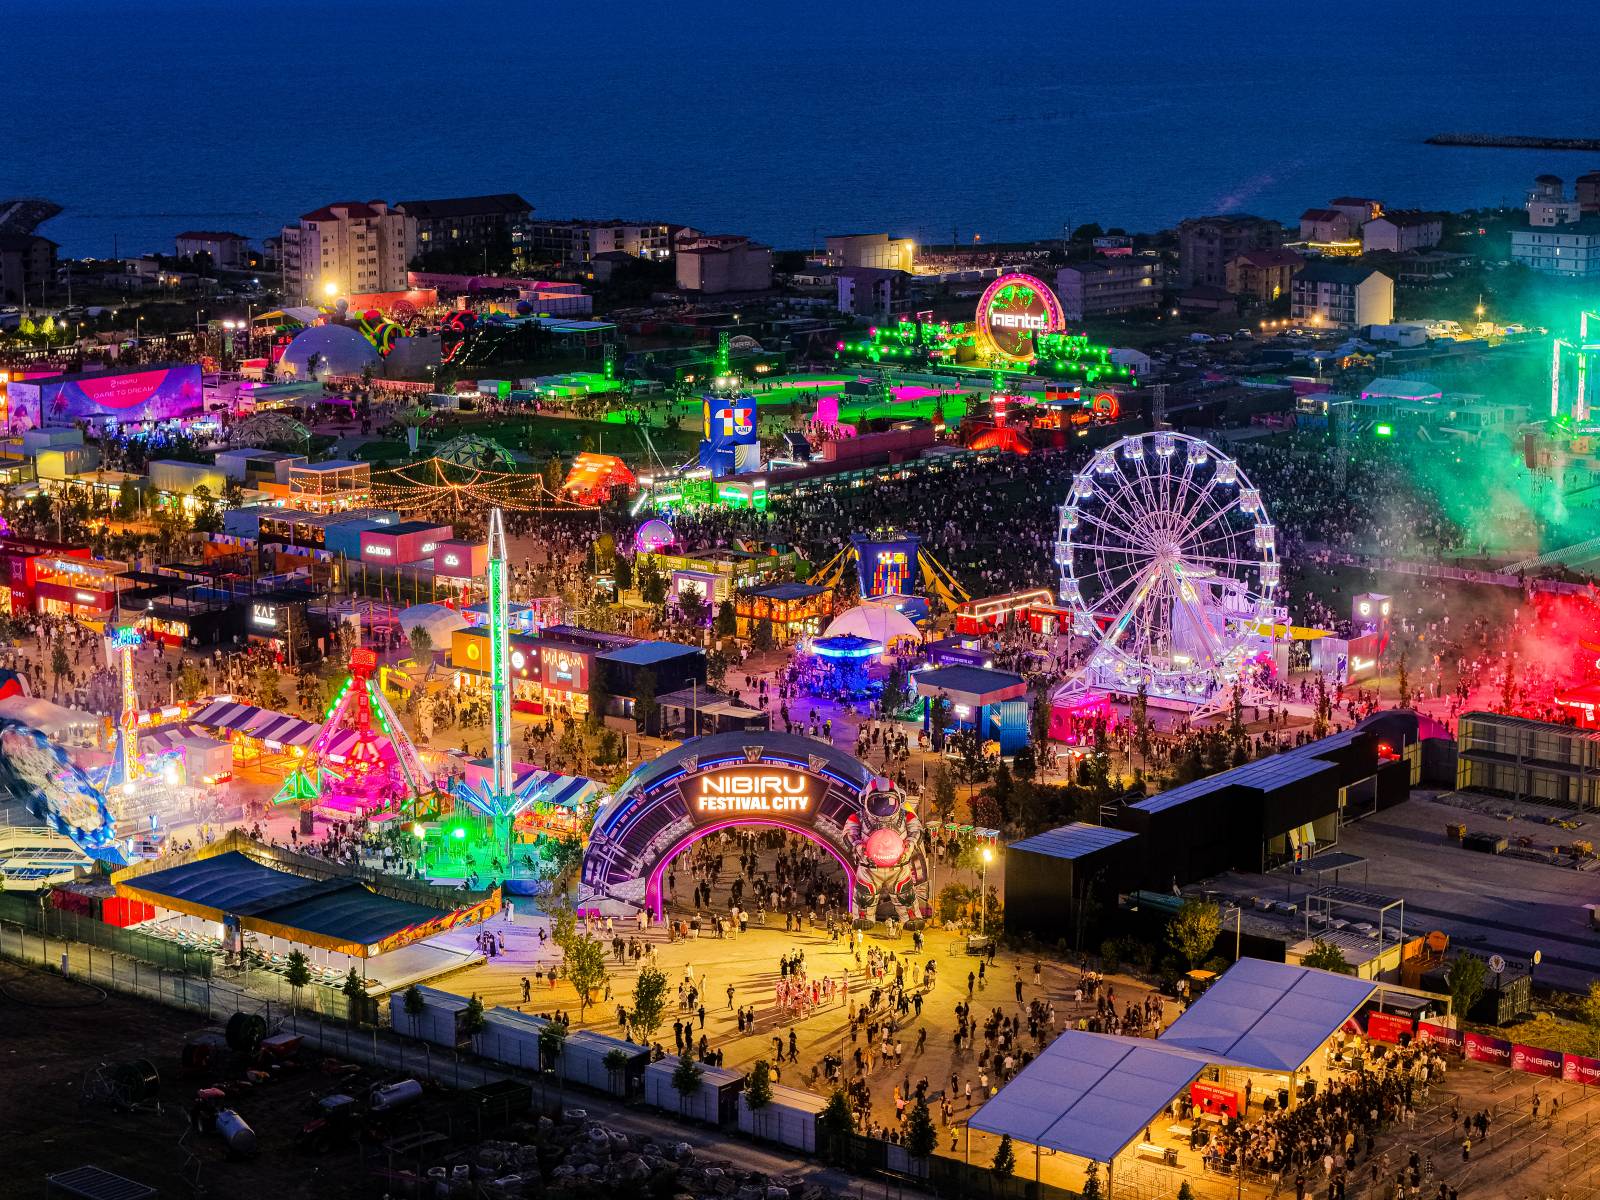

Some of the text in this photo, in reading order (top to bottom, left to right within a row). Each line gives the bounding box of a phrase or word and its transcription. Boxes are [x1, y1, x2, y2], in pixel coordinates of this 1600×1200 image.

[702, 776, 805, 794] NIBIRU
[699, 796, 809, 810] FESTIVAL CITY
[1429, 1034, 1462, 1047] NIBIRU
[1477, 1045, 1510, 1058] NIBIRU
[1525, 1056, 1561, 1069] NIBIRU
